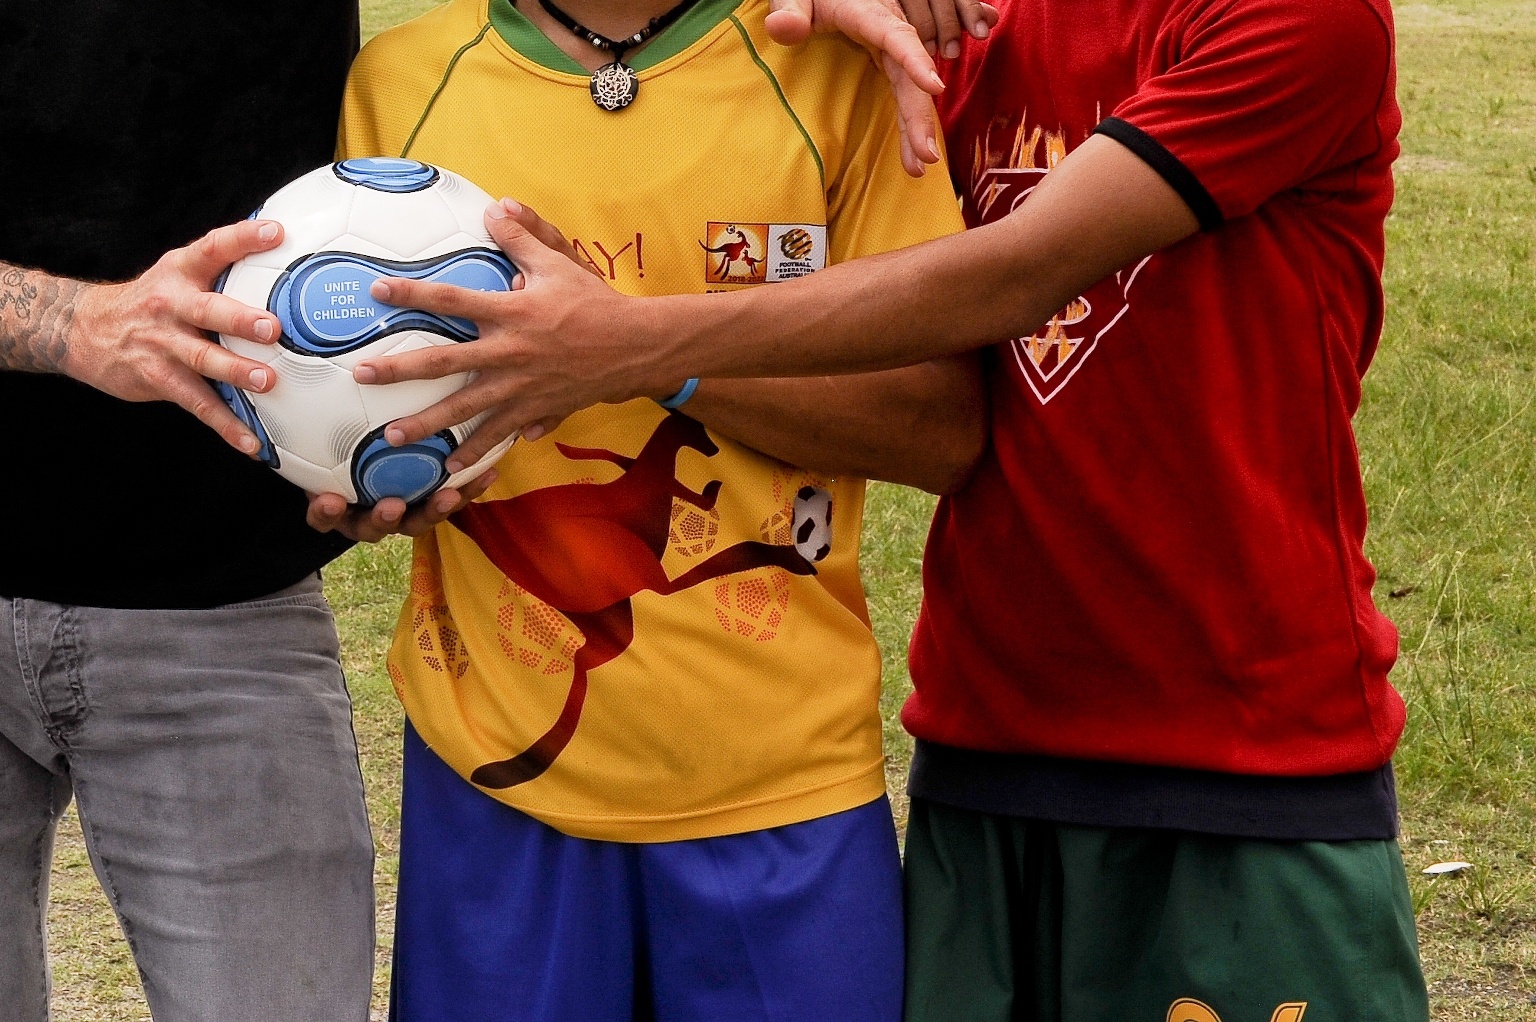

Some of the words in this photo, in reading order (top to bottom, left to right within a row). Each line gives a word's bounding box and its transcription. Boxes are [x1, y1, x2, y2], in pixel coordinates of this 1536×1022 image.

[572, 232, 645, 281] AY!
[324, 280, 360, 293] UNITE
[331, 294, 355, 305] FOR
[313, 307, 375, 321] CHILDREN
